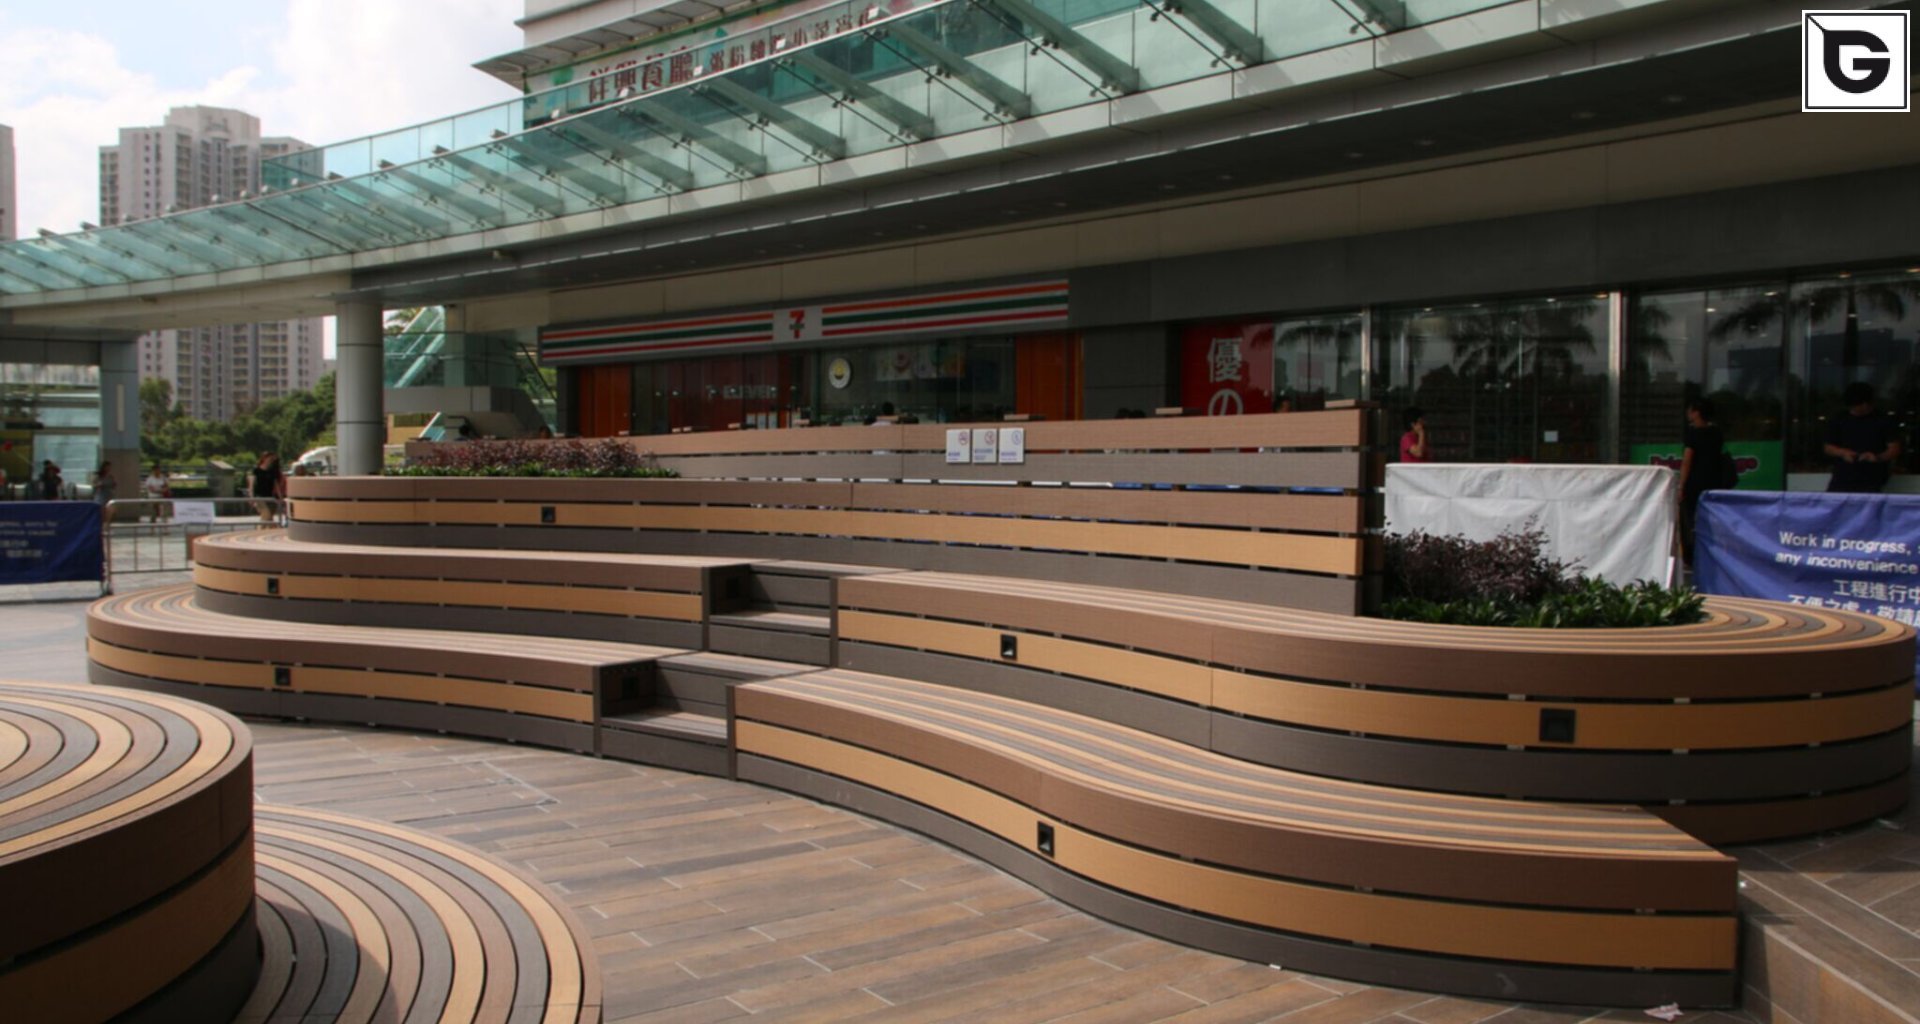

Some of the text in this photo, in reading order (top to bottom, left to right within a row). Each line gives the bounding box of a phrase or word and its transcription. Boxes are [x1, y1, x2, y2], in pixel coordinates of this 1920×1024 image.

[1779, 531, 1818, 547] Work
[1822, 534, 1836, 549] in
[1839, 537, 1912, 556] progress,
[1775, 552, 1919, 574] any inconvenience
[1833, 579, 1920, 605] 工程進行中
